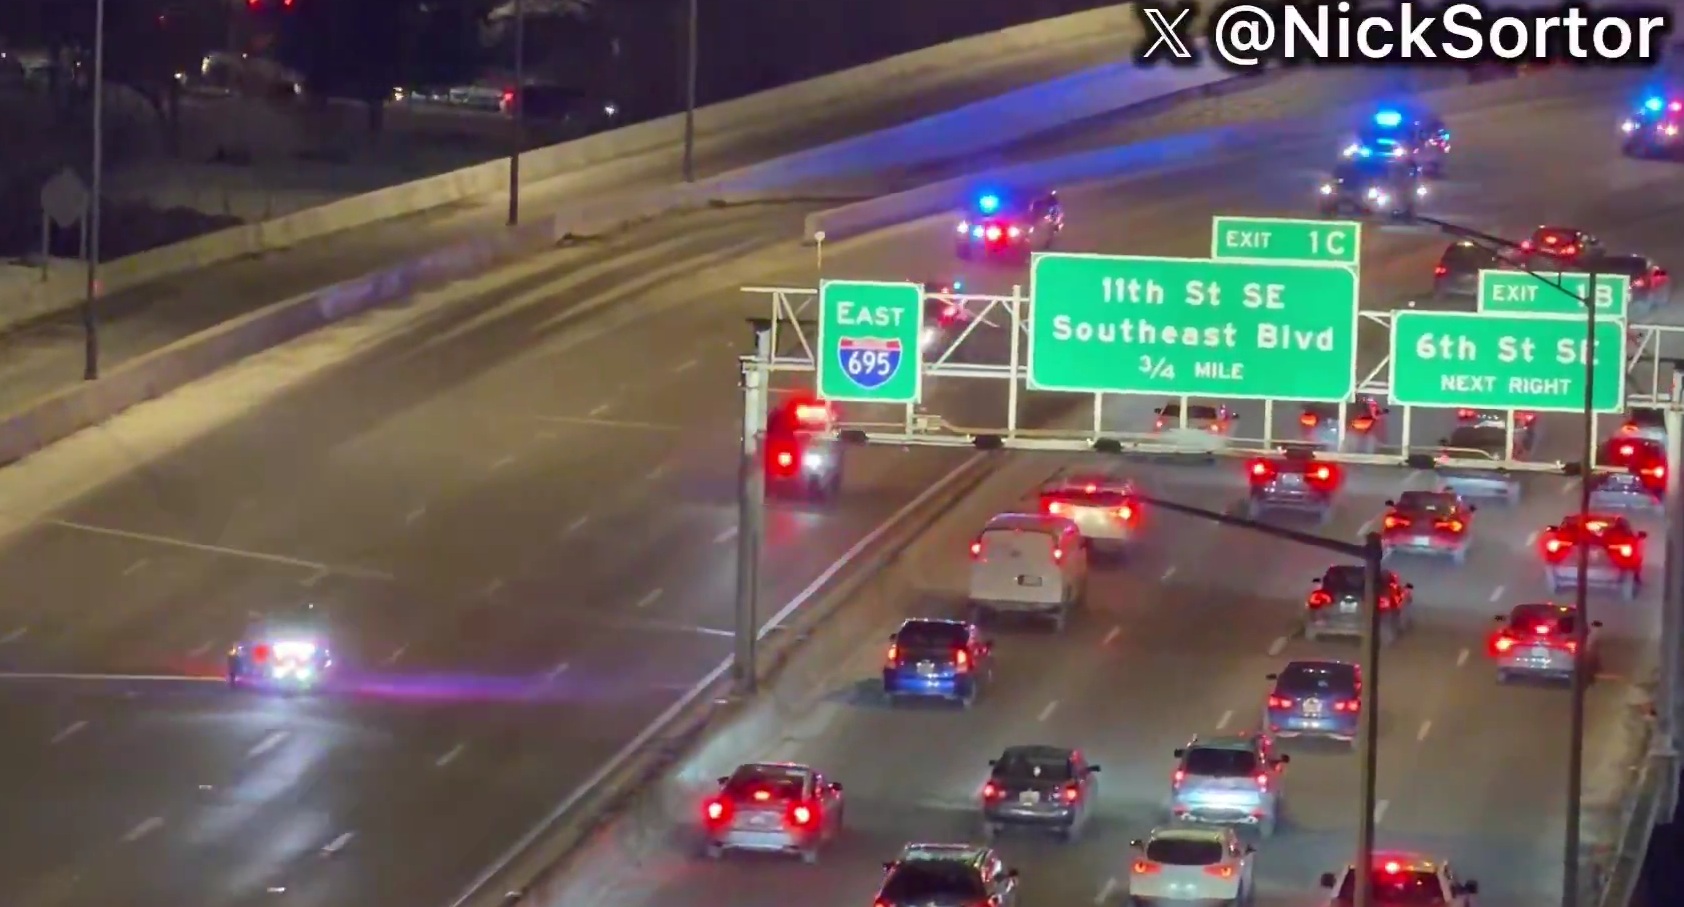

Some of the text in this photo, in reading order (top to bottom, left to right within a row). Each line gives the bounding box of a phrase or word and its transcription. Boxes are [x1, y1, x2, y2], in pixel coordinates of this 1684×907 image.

[1225, 230, 1346, 255] EXIT 1C
[1102, 276, 1286, 309] 11th St SE
[1491, 284, 1539, 303] EXIT
[836, 301, 905, 327] EAST
[1052, 314, 1334, 352] Southeast Blvd
[1415, 332, 1600, 366] 6th St SE
[848, 350, 890, 376] 695
[1138, 354, 1245, 381] 3/4 MILE
[1440, 374, 1573, 396] NEXT RIGHT
